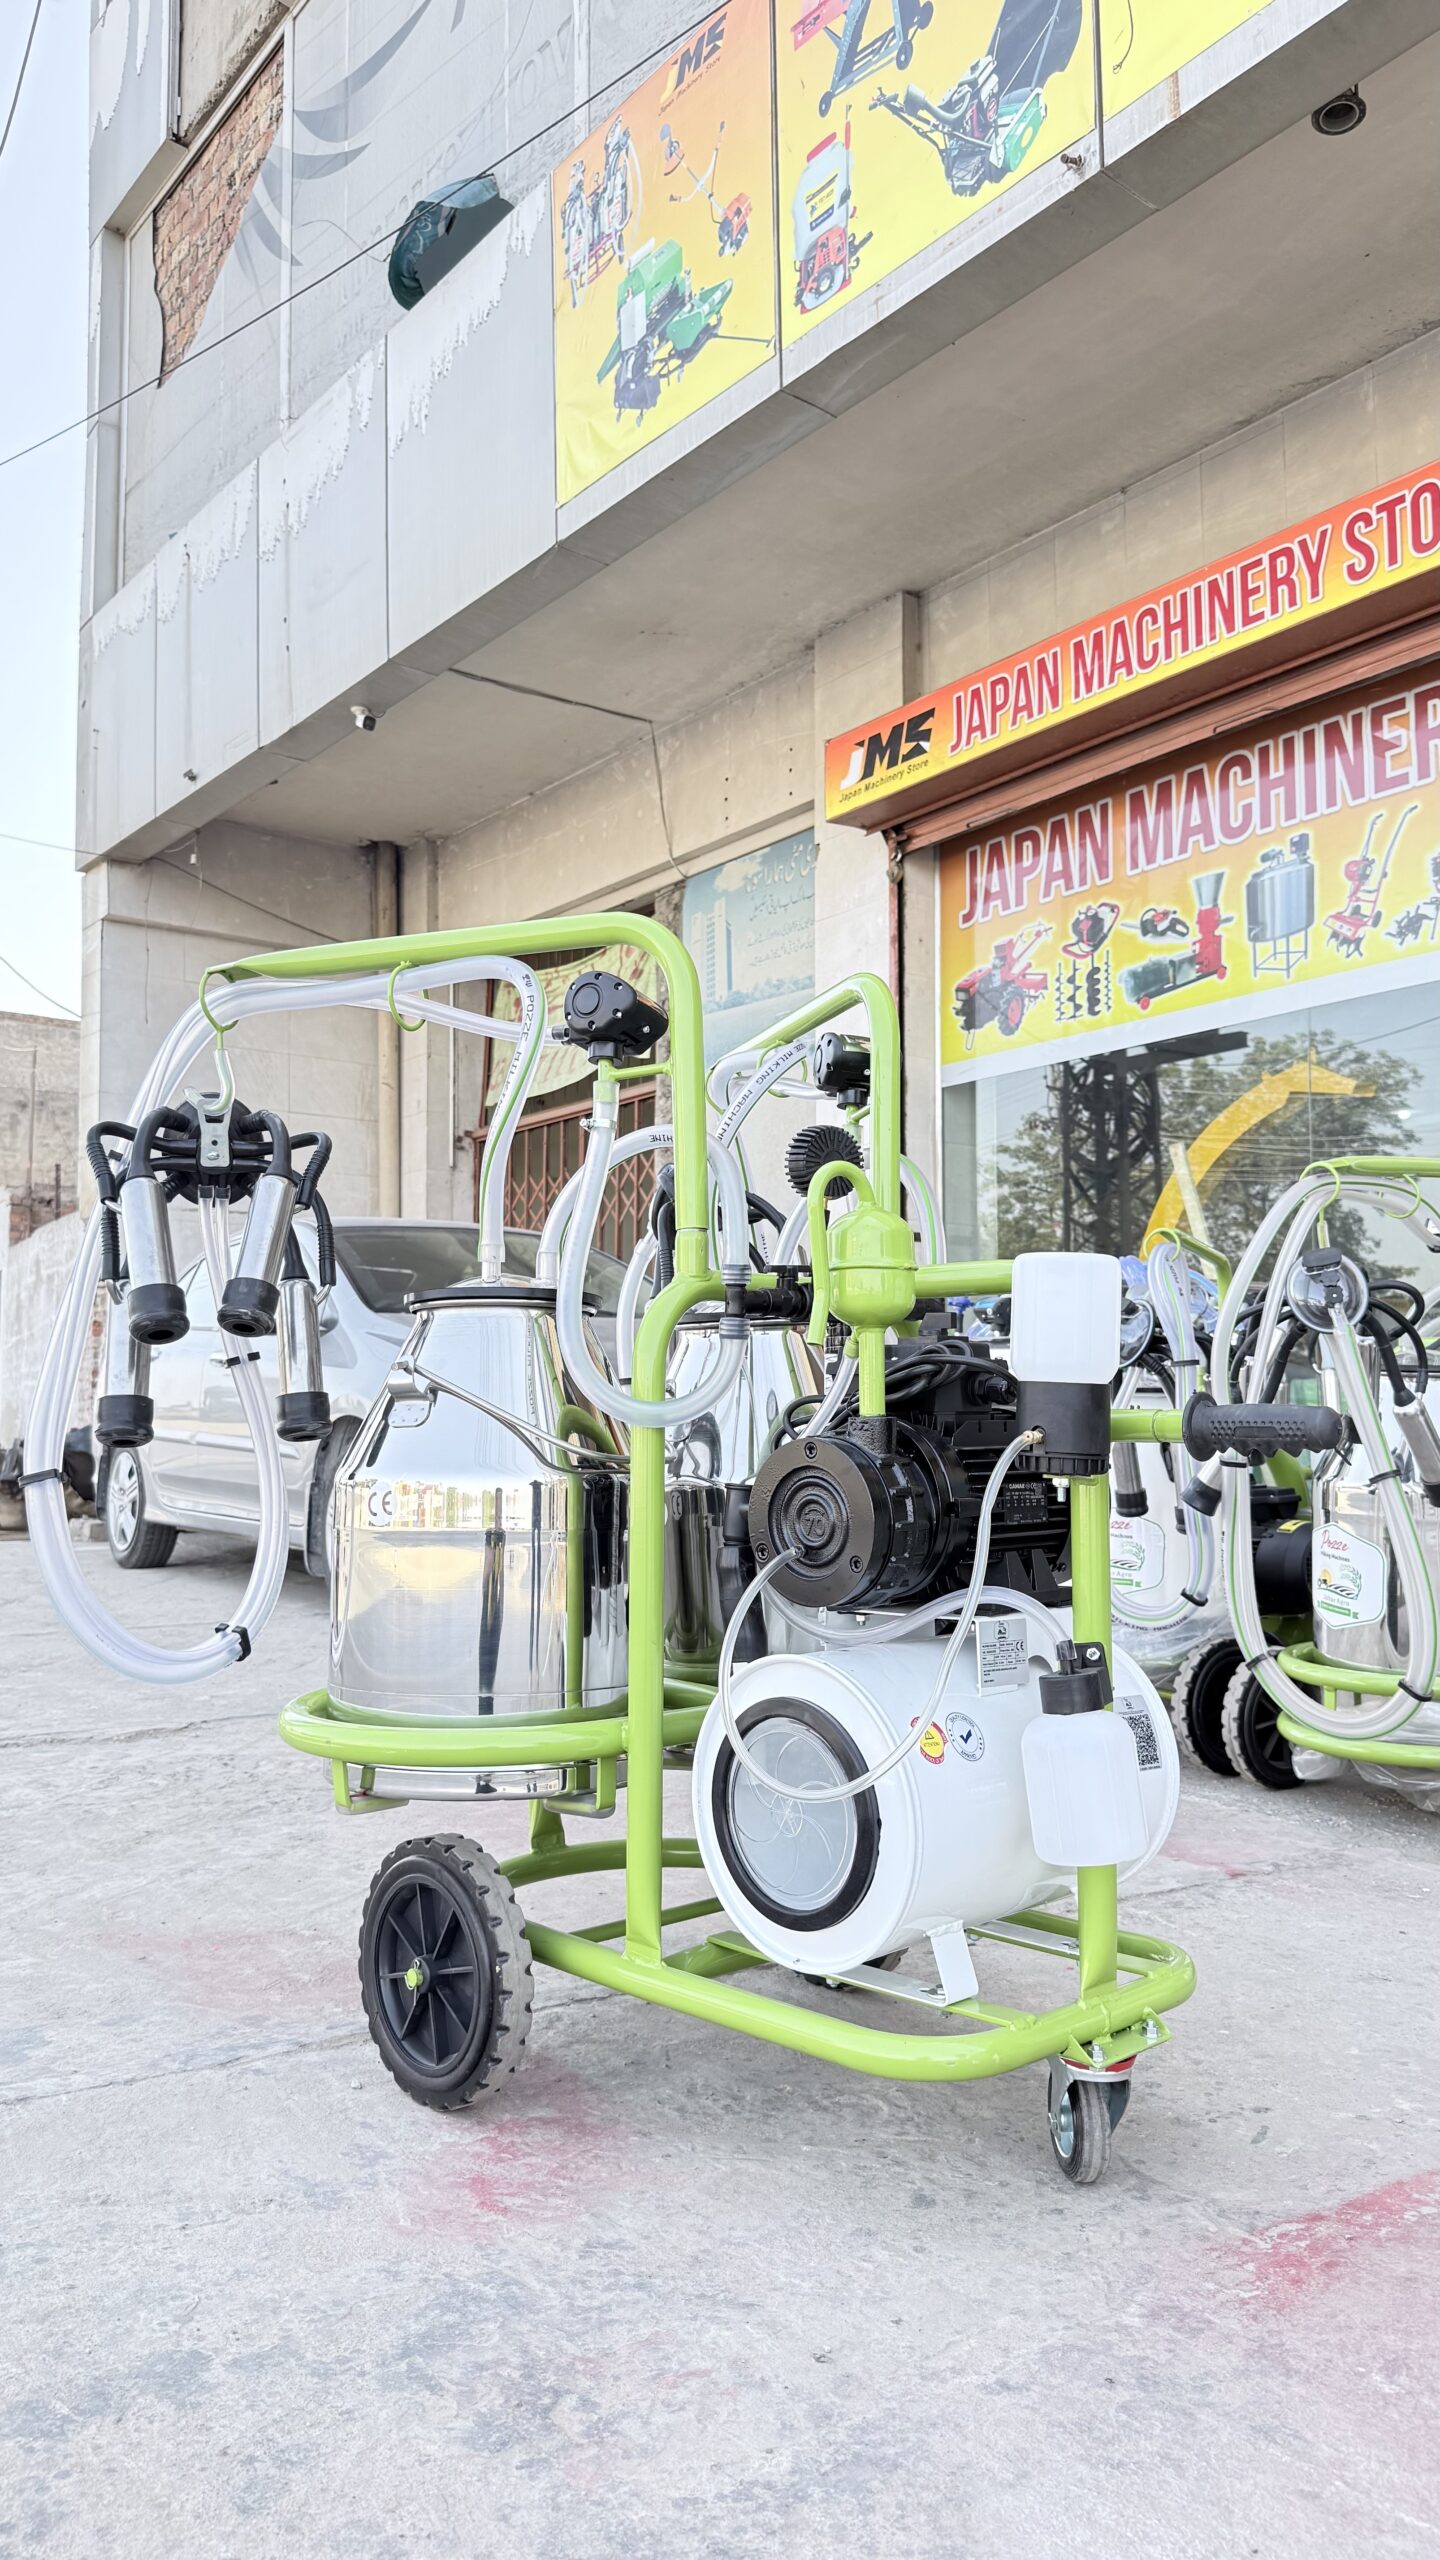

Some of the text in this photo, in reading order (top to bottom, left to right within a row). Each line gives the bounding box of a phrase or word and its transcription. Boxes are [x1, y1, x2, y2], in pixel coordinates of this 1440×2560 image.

[660, 12, 728, 104] JMS
[948, 479, 1440, 755] JAPAN MACHINERY STO
[839, 706, 936, 791] JMS
[839, 759, 929, 803] Japan Machinery Store
[960, 683, 1440, 927] JAPAN MACHINER
[521, 994, 535, 1043] POZZE
[755, 1050, 793, 1085] MILKING
[367, 1490, 392, 1517] CE
